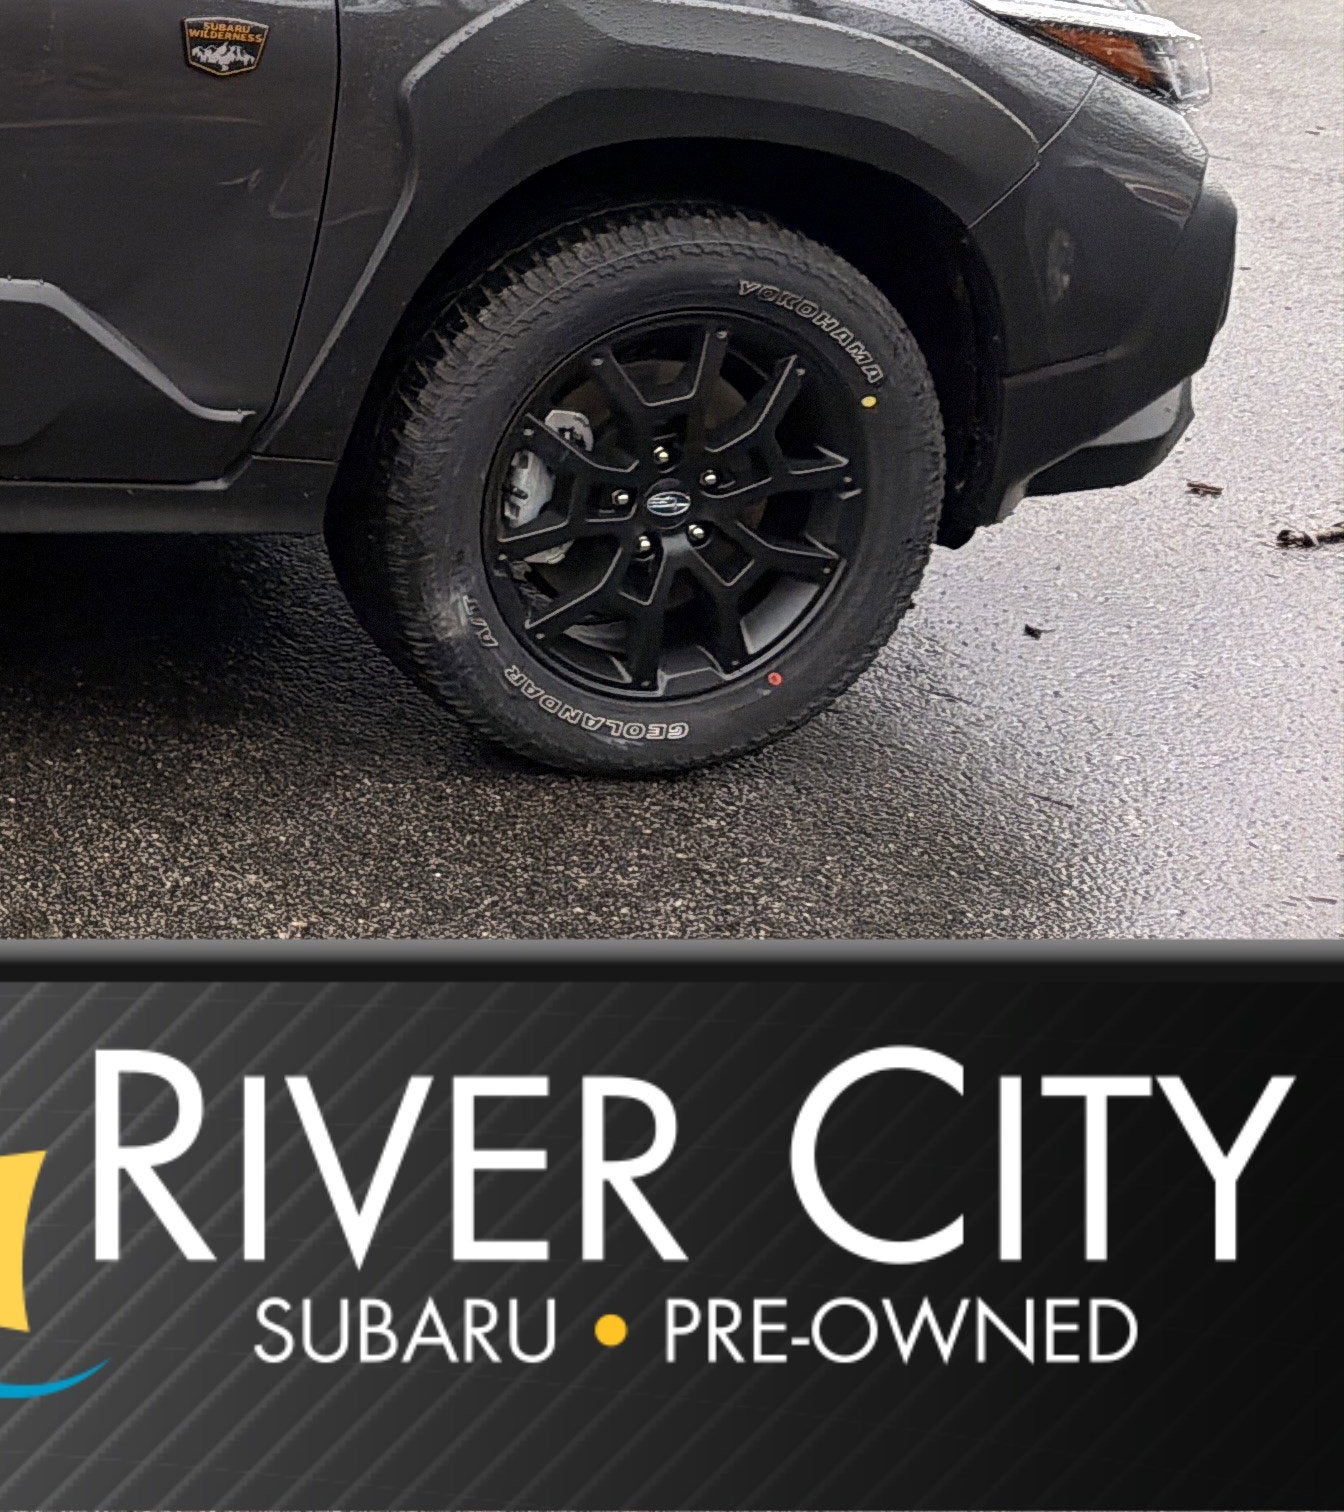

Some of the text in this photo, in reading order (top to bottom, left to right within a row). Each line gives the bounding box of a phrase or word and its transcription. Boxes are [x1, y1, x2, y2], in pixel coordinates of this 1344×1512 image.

[188, 28, 263, 43] WILDERNESS
[203, 21, 250, 34] SUBARU
[738, 279, 884, 384] YOKOHAMA
[504, 664, 689, 740] GEOLANDAR
